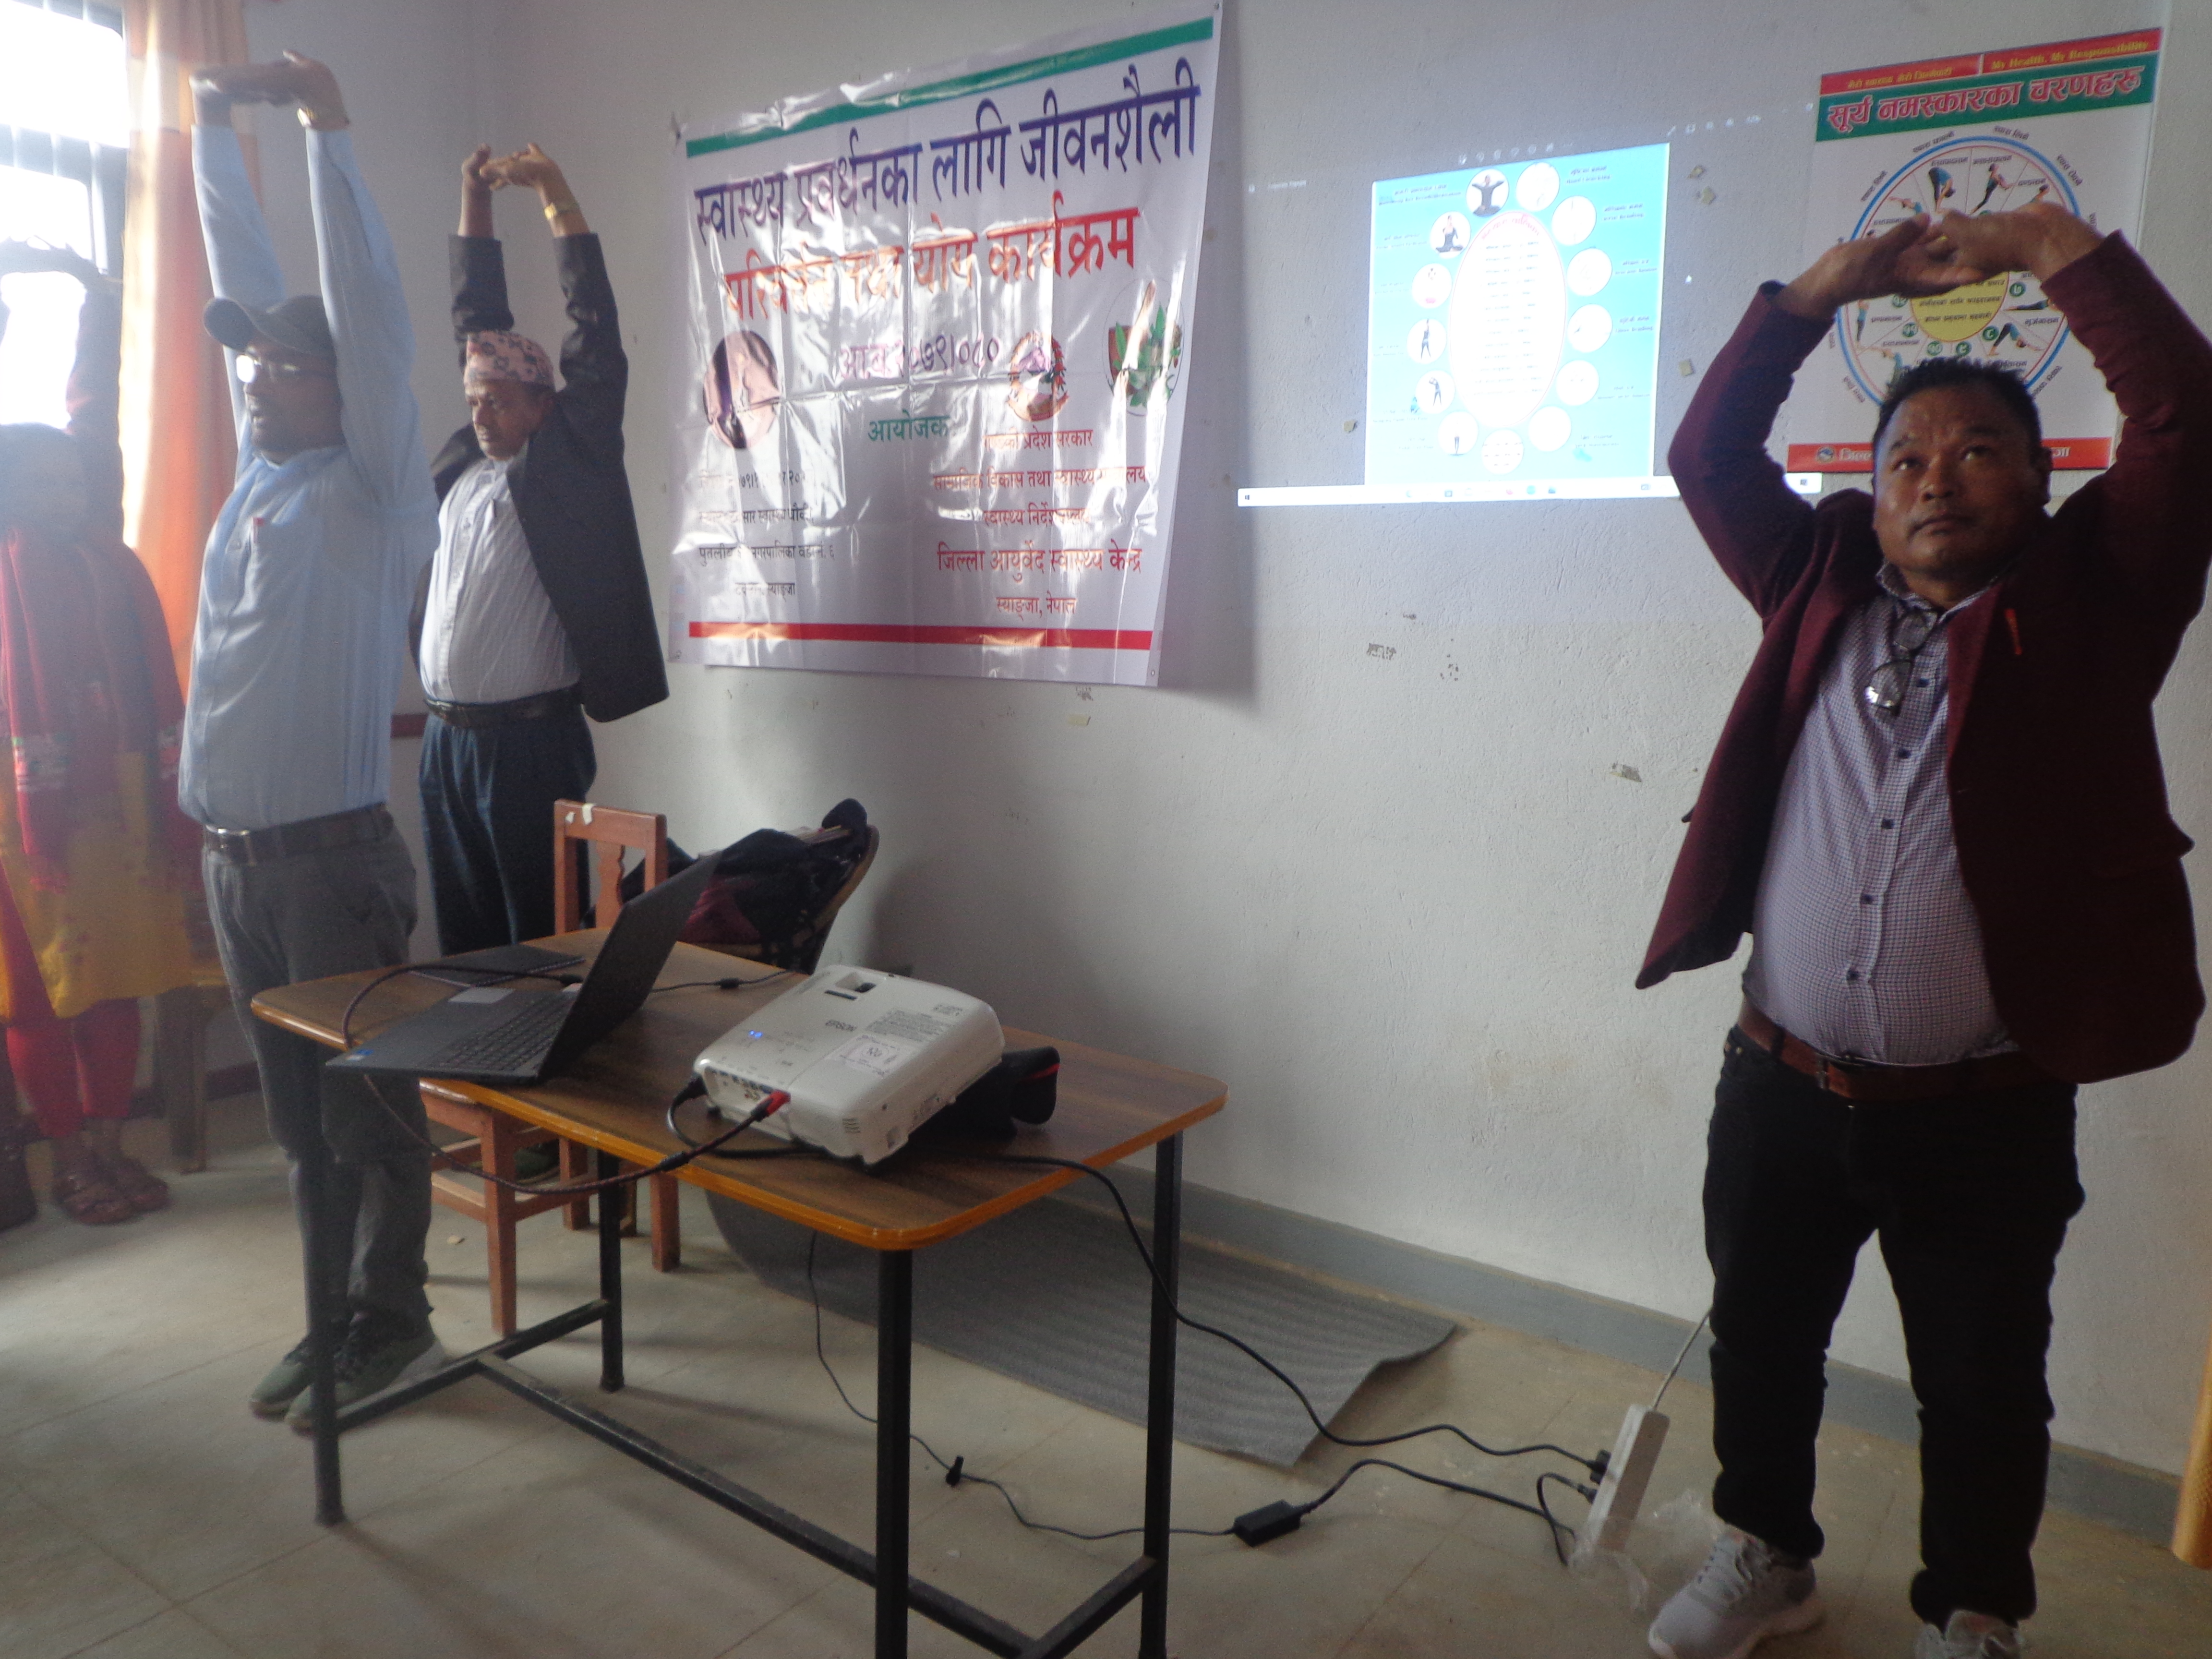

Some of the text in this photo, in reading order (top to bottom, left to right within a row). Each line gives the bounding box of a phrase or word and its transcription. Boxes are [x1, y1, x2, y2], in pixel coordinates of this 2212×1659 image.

[1992, 61, 2006, 70] My
[2050, 52, 2065, 62] My
[2069, 41, 2148, 59] Responsibility
[1827, 94, 1874, 133] सूर्य
[1877, 82, 2023, 120] नमस्कारका
[694, 171, 788, 246] स्वास्थ्य
[929, 98, 1011, 202] लागि
[1019, 57, 1202, 181] जीवनशैली
[986, 189, 1140, 283] कार्यक्रम
[868, 408, 950, 443] आयोजक
[1023, 425, 1052, 451] प्रदेश
[1055, 429, 1093, 447] सरकार
[987, 466, 1023, 489] विकास
[1027, 470, 1051, 487] तथा
[983, 509, 1025, 526] स्वास्थ्य
[751, 540, 796, 560] नगरपालिका
[937, 539, 1142, 584] जिल्ला आयुर्वेद स्वास्थ्य केन्द्र
[996, 590, 1077, 622] स्याङ्जा, नेपाल
